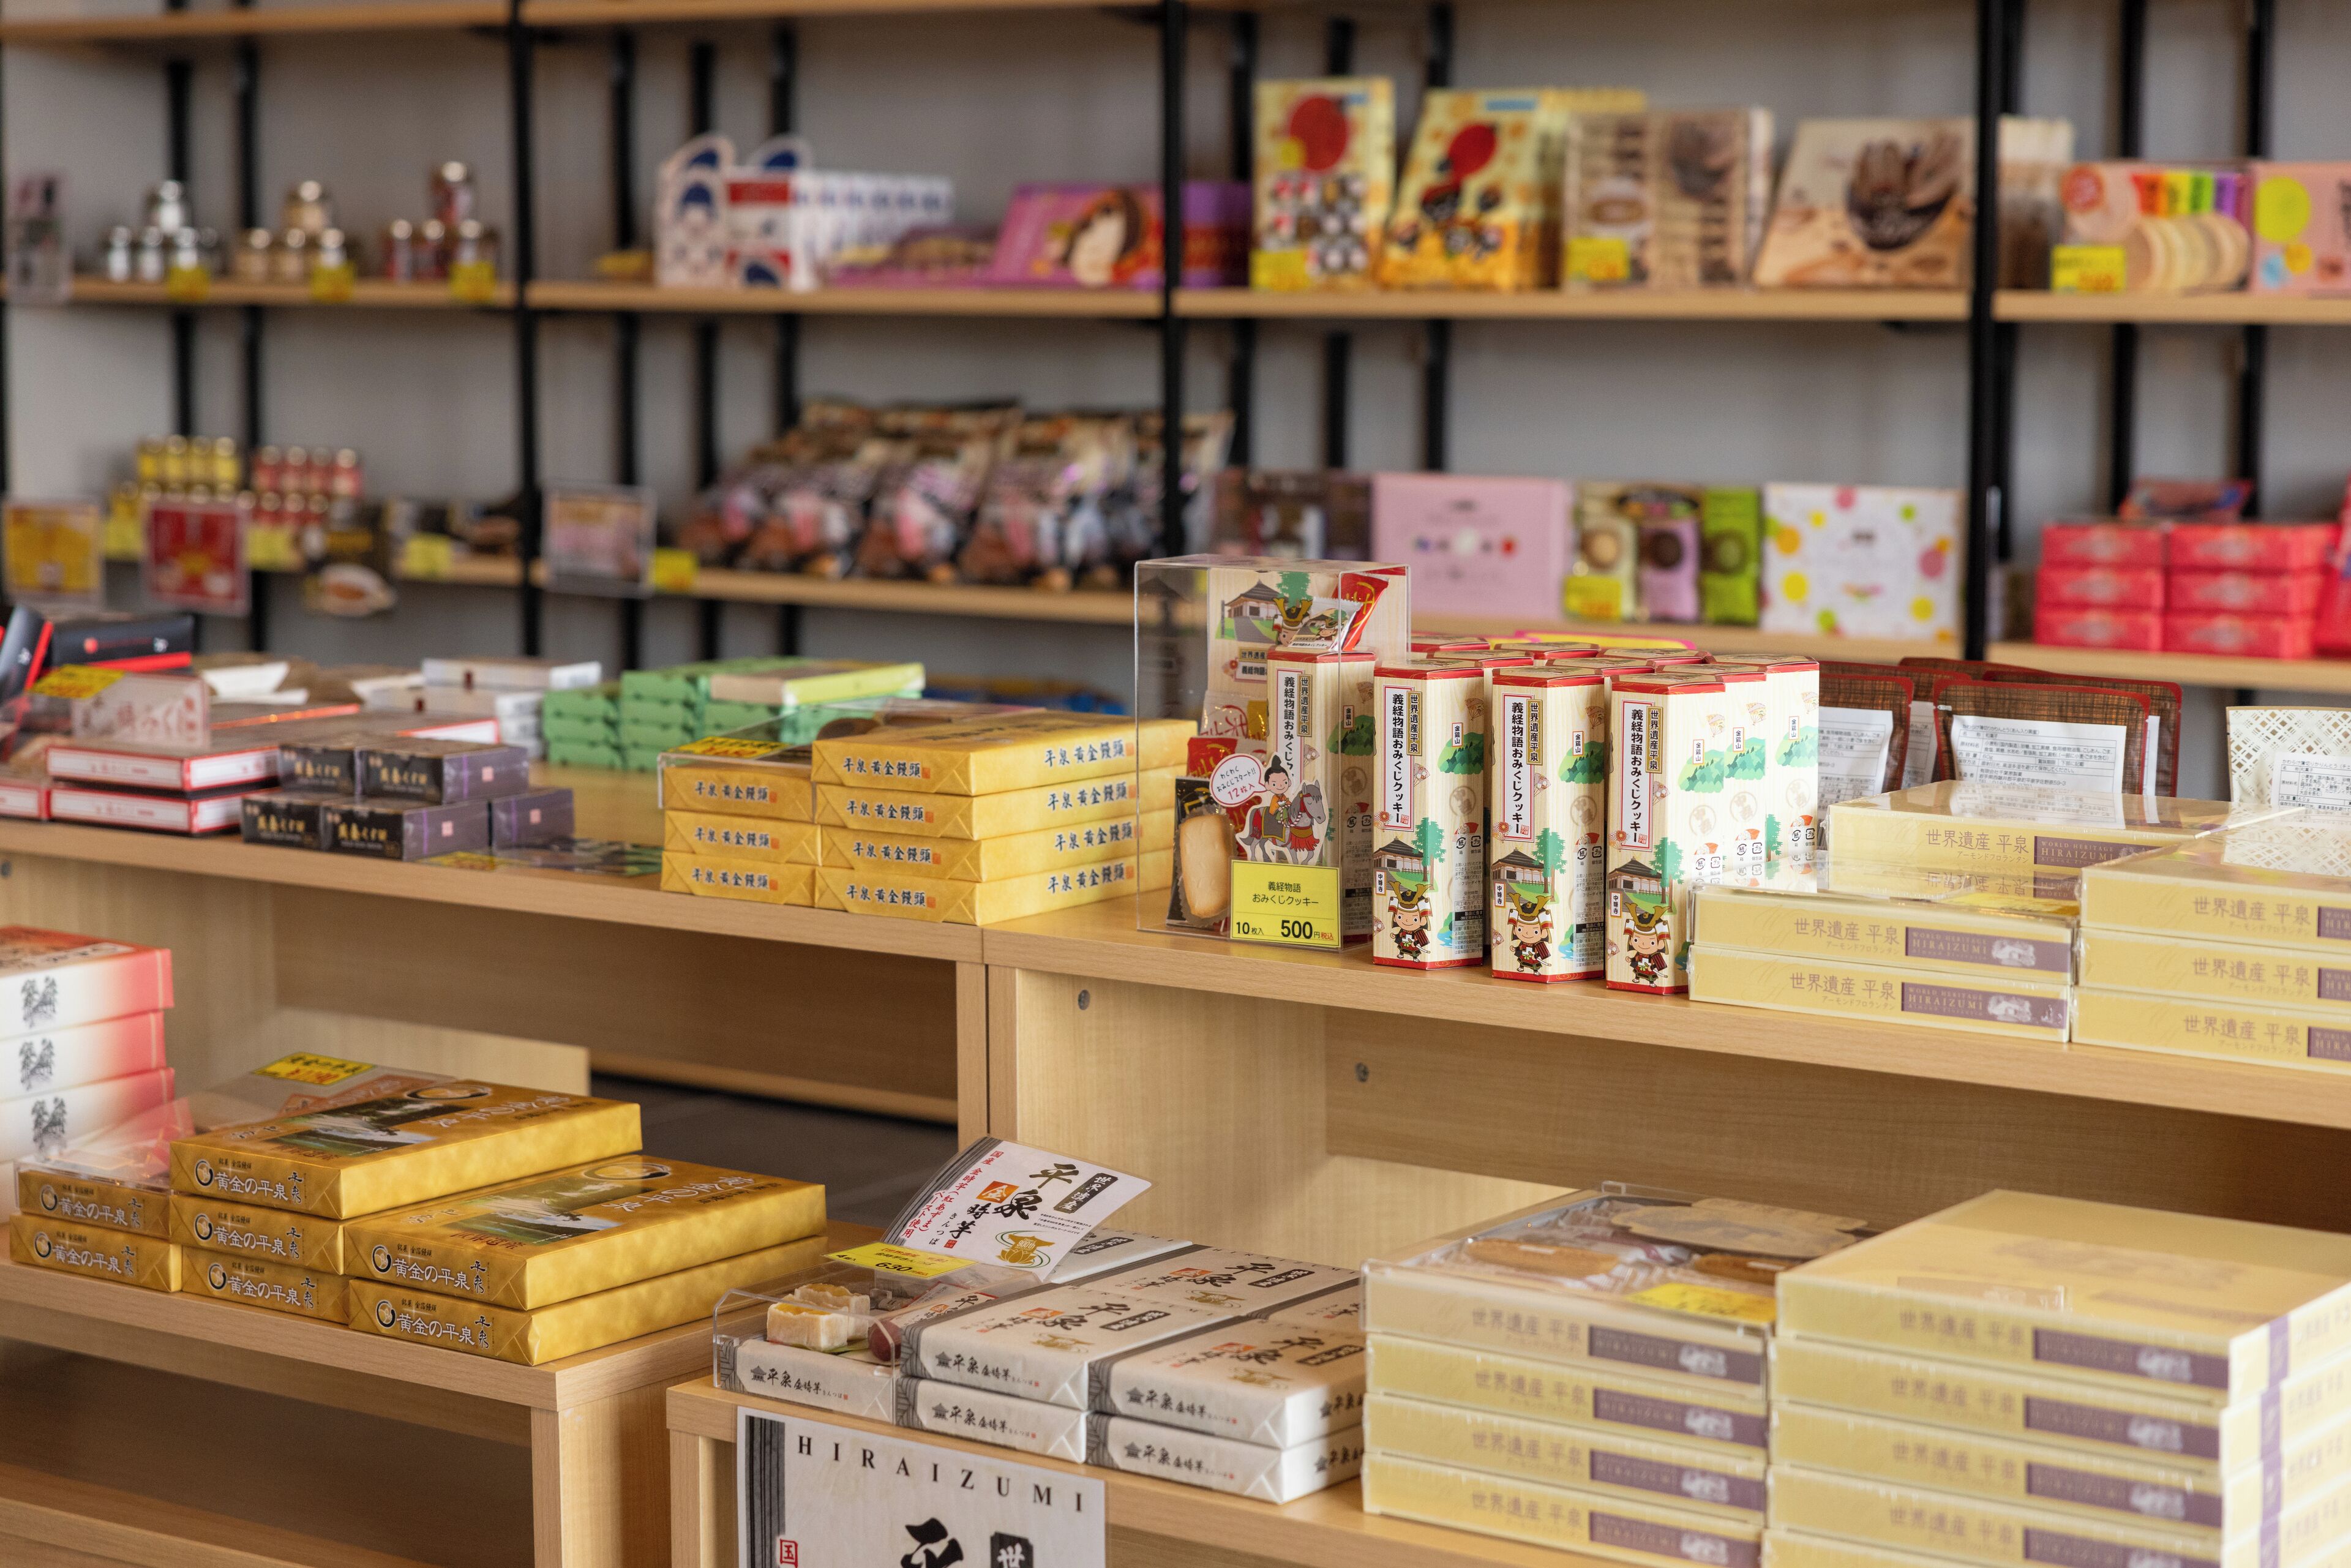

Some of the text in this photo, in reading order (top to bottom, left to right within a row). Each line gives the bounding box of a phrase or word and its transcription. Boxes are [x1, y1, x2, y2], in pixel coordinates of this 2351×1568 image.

[1284, 677, 1295, 776] 義経物語おみくじク
[1410, 695, 1419, 752] 世界遺産平泉
[1530, 703, 1539, 762] 世界遺産平泉
[1649, 710, 1659, 770] 世界遺産平泉
[844, 758, 867, 773] 平泉
[1044, 748, 1070, 767] 平泉
[1392, 694, 1404, 823] 義経物語おみくじクッキー
[1512, 702, 1523, 834] 義経物語おみくじクッキー
[1220, 765, 1239, 779] わくわく
[1630, 709, 1643, 842] 義経物語おみくじクッキー
[696, 781, 717, 797] 平泉
[1048, 790, 1073, 811] 平泉
[1228, 784, 1254, 800] 12枚入
[847, 800, 871, 816] 平泉
[696, 827, 717, 843] 平泉
[1054, 831, 1079, 852] 平泉
[1925, 829, 2029, 854] 世界遺産 平泉
[853, 841, 876, 858] 平泉
[2042, 848, 2113, 860] HIRAIZUMI
[692, 868, 714, 884] 平泉
[1048, 874, 1072, 894] 平泉
[1268, 882, 1301, 893] 義経物語
[846, 885, 869, 902] 平泉
[1252, 895, 1319, 906] おみくじクッキー
[2194, 896, 2265, 920] 世界遺産
[2273, 904, 2311, 925] 平泉
[1794, 918, 1899, 945] 世界遺産 平泉
[1789, 973, 1895, 999] 世界遺産 平泉
[2192, 958, 2265, 982] 世界遺産
[2273, 965, 2311, 986] 平泉
[2184, 1015, 2301, 1045] 世界遺産 平泉
[981, 1150, 1004, 1165] 国産
[214, 1172, 288, 1202] 黄金の平泉
[993, 1163, 1079, 1220] 平泉
[59, 1198, 127, 1226] 黄金の平泉
[901, 1191, 945, 1238] ペースト使用
[214, 1226, 287, 1256] 黄金の平泉
[929, 1213, 957, 1245] きんつば
[53, 1245, 121, 1274] 黄金の平泉
[392, 1258, 470, 1290] 黄金の平泉
[228, 1275, 301, 1306] 黄金の平泉
[397, 1313, 475, 1345] 黄金の平泉
[798, 1435, 1083, 1512] HIRAIZUMI
